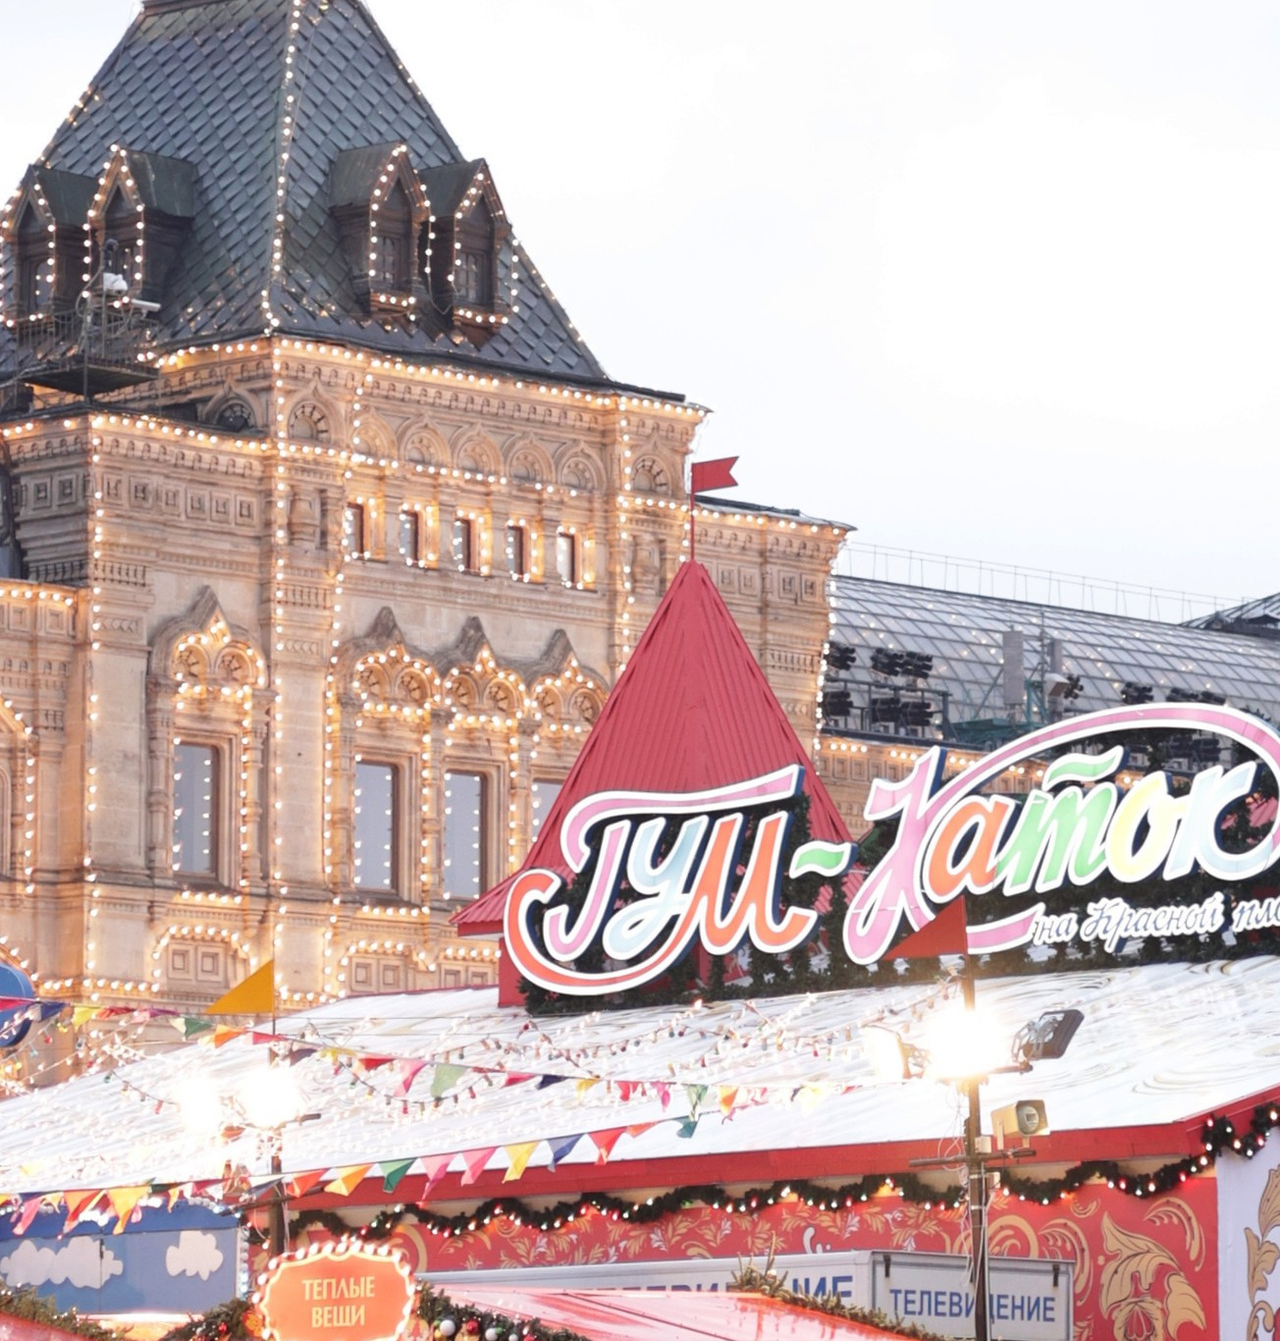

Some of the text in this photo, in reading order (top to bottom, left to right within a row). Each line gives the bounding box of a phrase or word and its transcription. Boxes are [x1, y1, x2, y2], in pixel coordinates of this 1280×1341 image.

[1034, 912, 1078, 945] на
[1080, 892, 1225, 953] Красной
[302, 1276, 375, 1301] ТЕПЛЫЕ
[311, 1305, 365, 1328] ВЕЩИ
